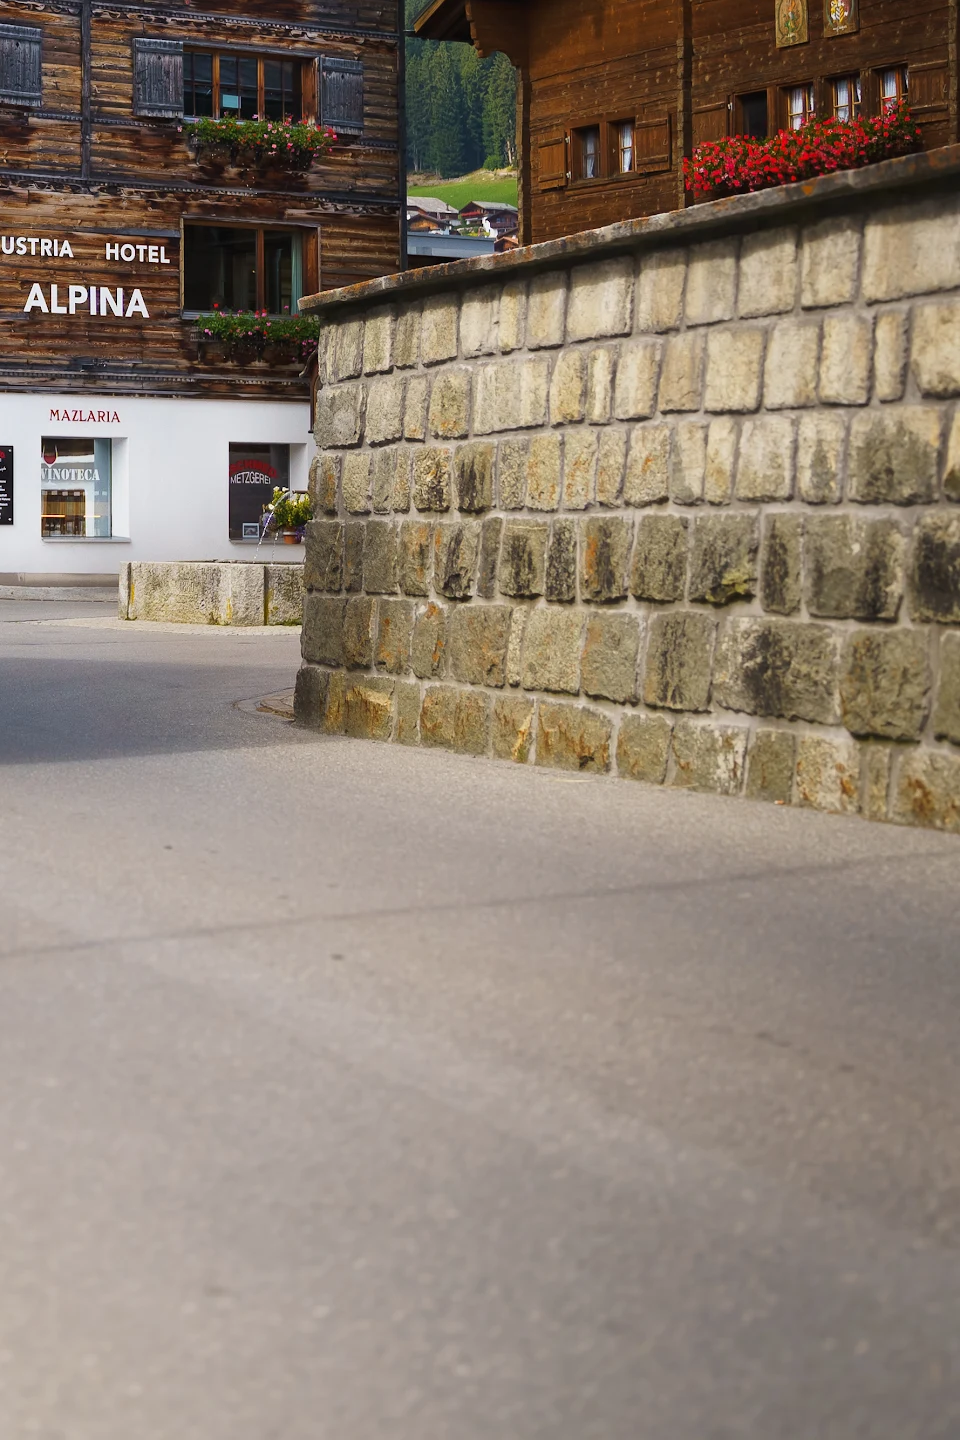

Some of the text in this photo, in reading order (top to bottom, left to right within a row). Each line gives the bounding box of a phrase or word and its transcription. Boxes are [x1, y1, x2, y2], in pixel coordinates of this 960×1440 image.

[1, 236, 171, 264] USTRIA HOTEL
[23, 282, 150, 319] ALPINA
[49, 409, 121, 423] MAZLARIA
[41, 467, 101, 481] VINOTECA
[230, 471, 271, 484] METZGEREI
